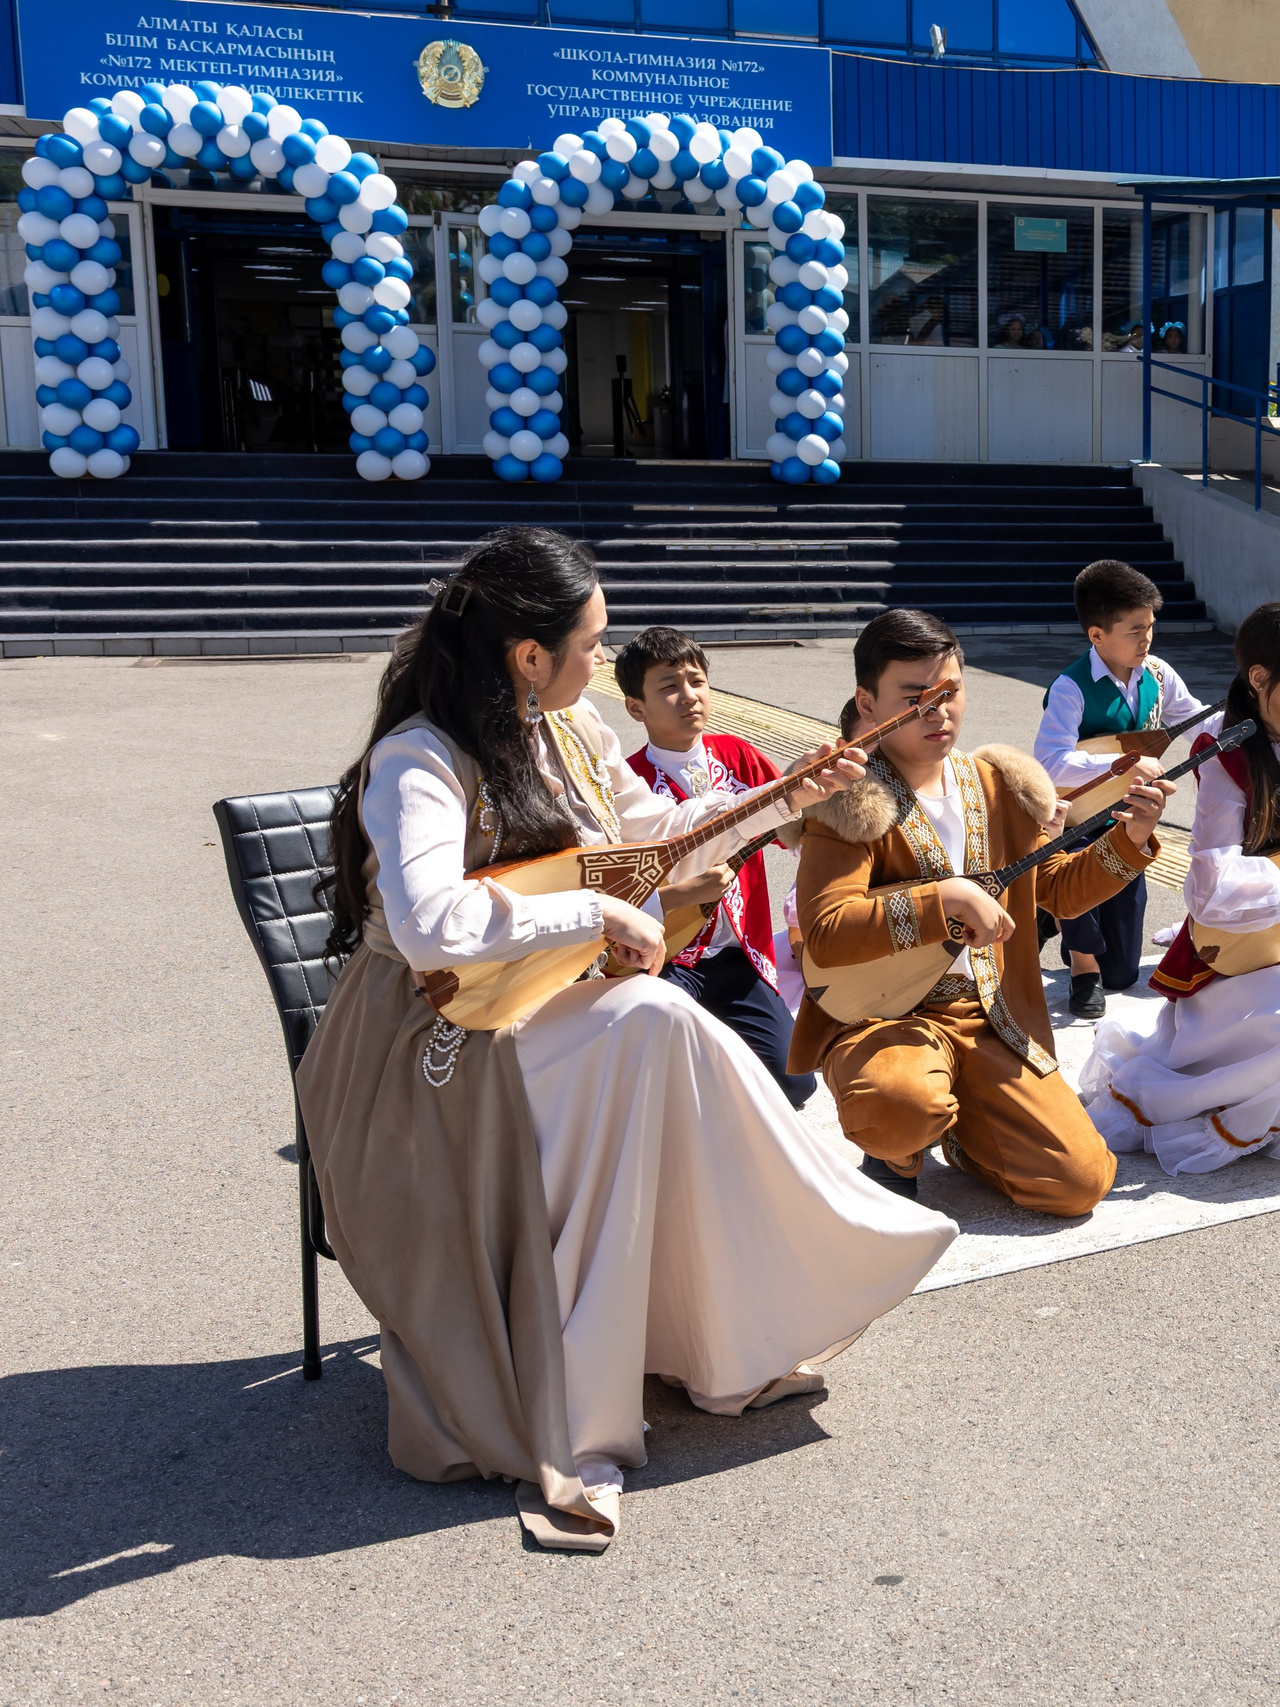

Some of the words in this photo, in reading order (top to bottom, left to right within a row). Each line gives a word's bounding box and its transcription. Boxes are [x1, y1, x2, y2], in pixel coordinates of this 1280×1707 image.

[137, 16, 218, 34] АЛМАТЫ
[225, 23, 303, 42] ҚАЛАСЫ
[105, 33, 159, 49] БІЛІМ
[166, 38, 336, 65] БАСҚАРМАСЫНЫҢ
[552, 47, 717, 71] «ШКОЛА-ГИМНАЗИЯ
[721, 59, 766, 73] №172»
[99, 54, 152, 70] «№172
[159, 58, 344, 83] МЕКТЕП-ГИМНАЗИЯ»
[591, 69, 730, 90] КОММУНАЛЬНОЕ
[526, 83, 683, 106] ГОСУДАРСТВЕННОЕ
[688, 94, 793, 113] УЧРЕЖДЕНИЕ
